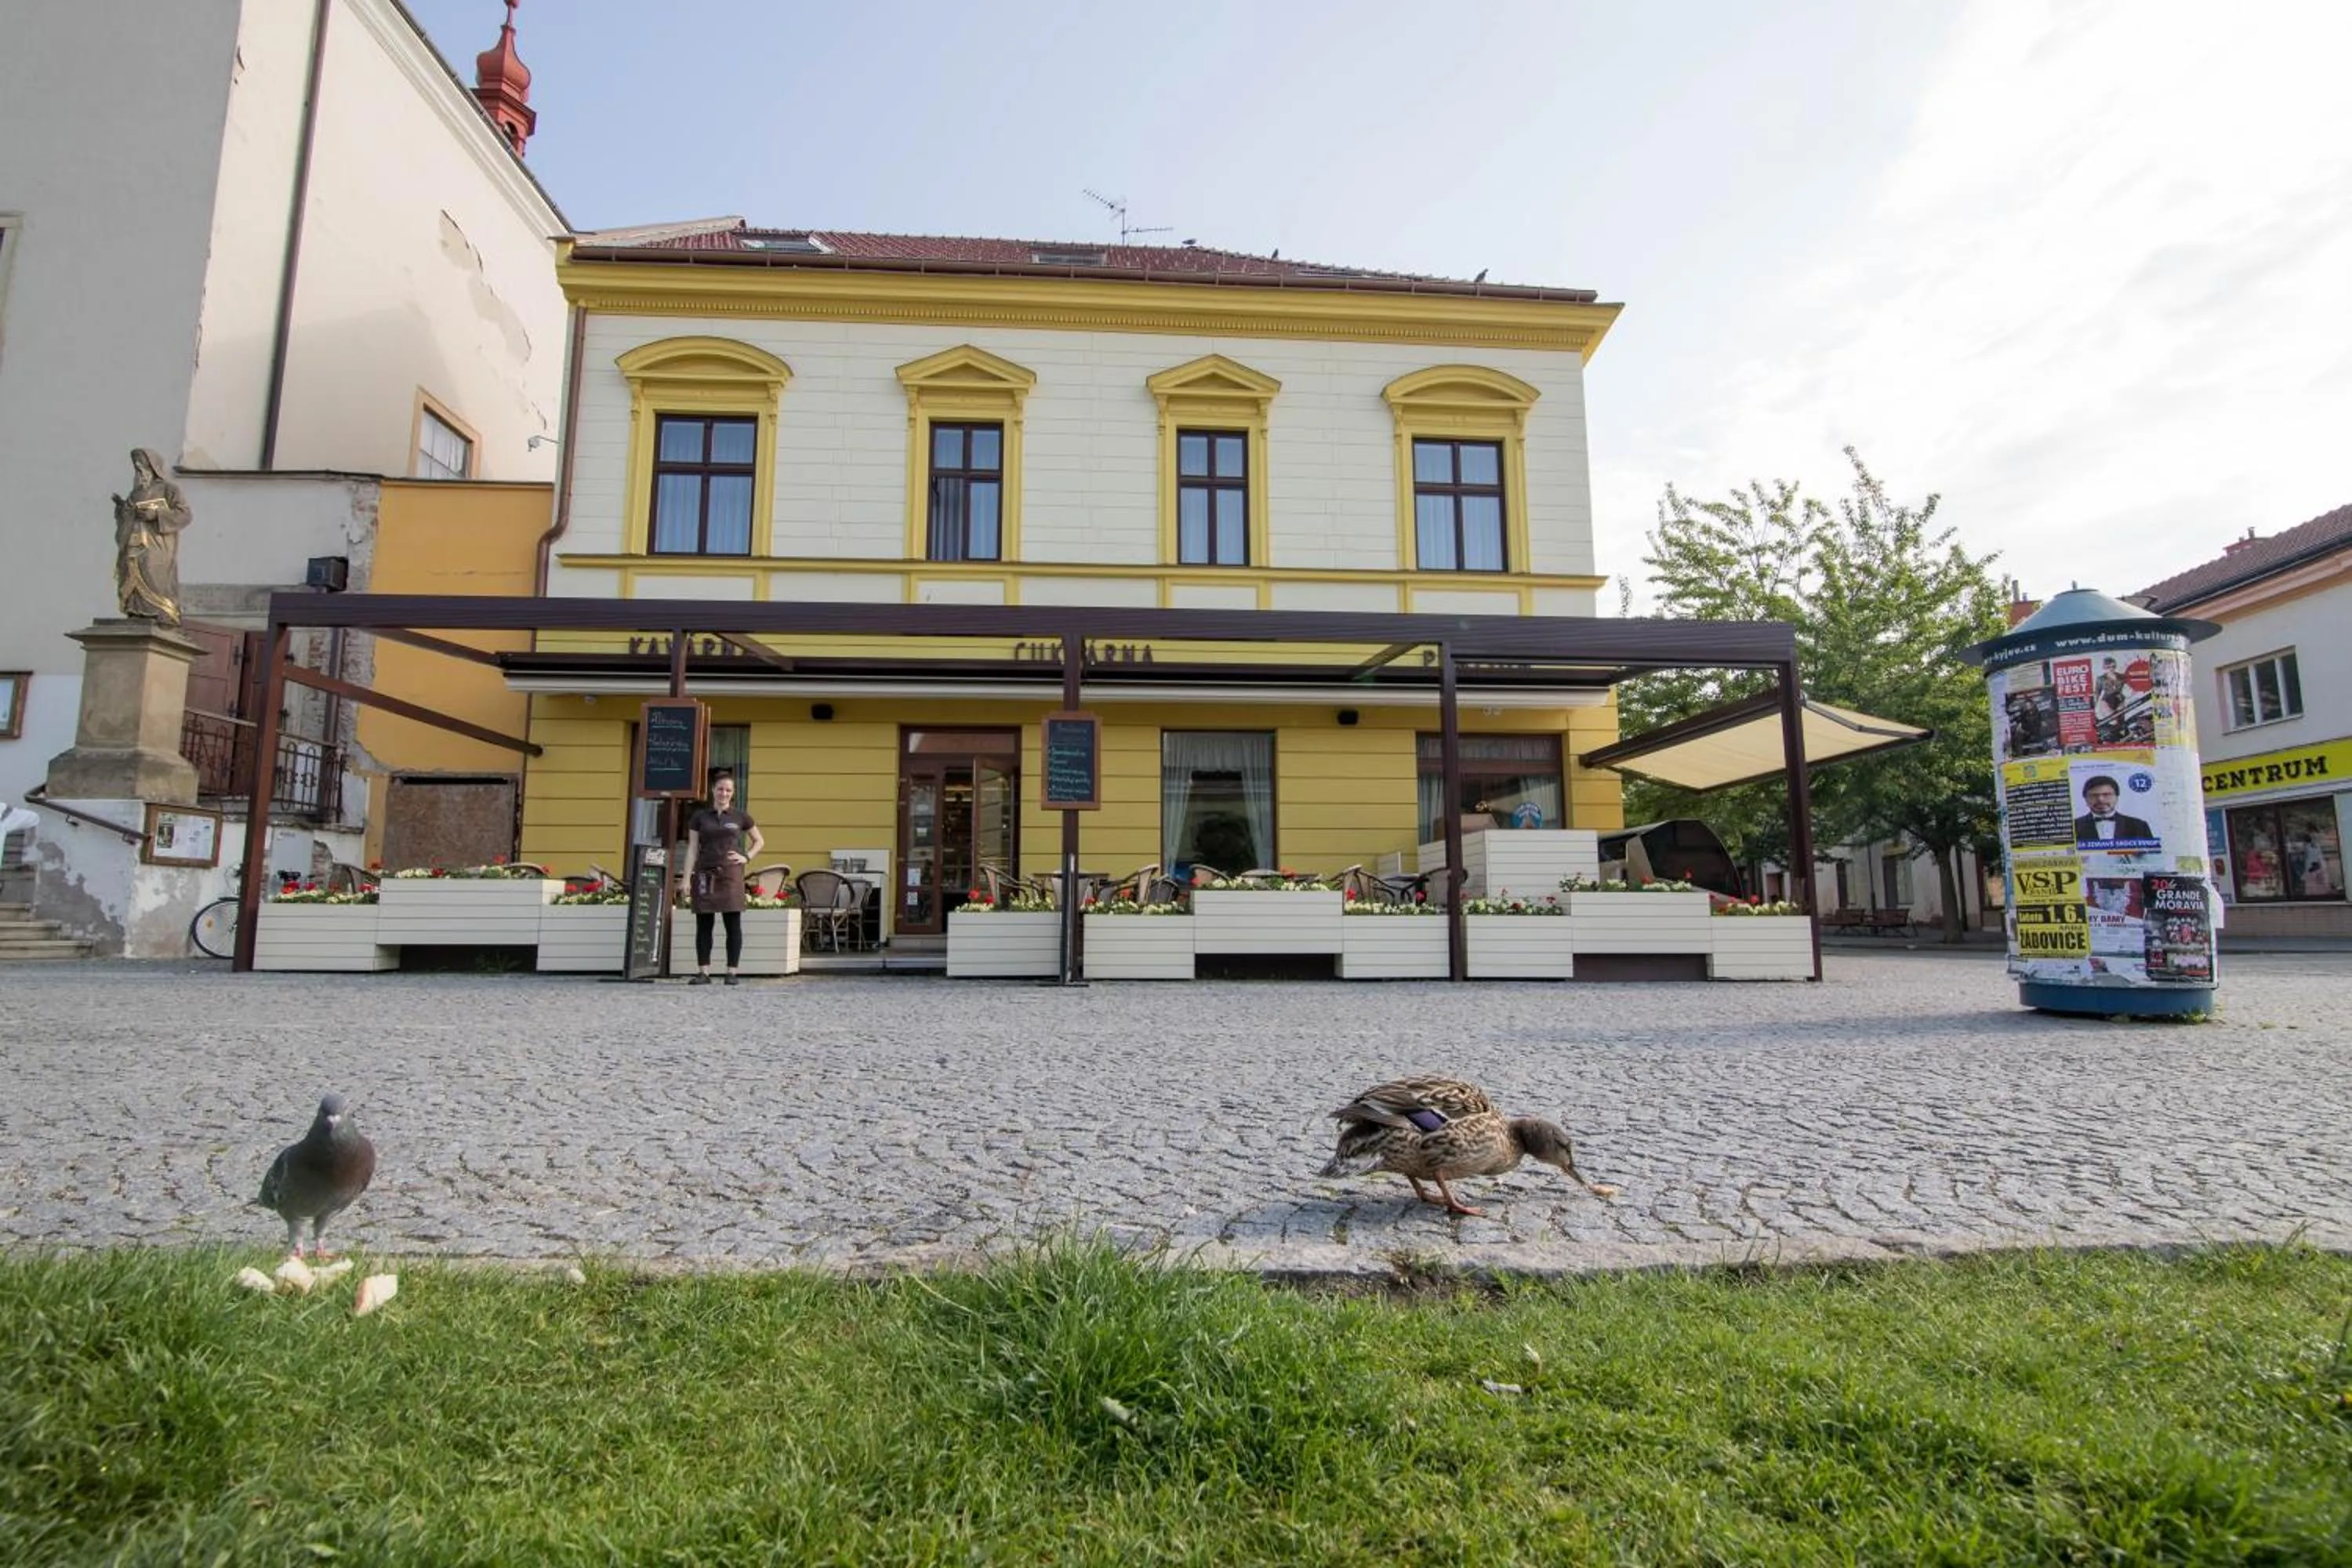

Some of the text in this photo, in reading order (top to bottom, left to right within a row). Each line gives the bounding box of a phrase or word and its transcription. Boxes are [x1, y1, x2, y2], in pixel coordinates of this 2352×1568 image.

[1014, 639, 1153, 663] CUKÁRNA
[2056, 664, 2089, 674] EURO
[2056, 674, 2087, 684] BIKE
[2057, 684, 2087, 695] FEST
[2201, 755, 2329, 793] CENTRUM
[2156, 890, 2201, 901] GRANDE
[2155, 900, 2205, 911] MORAVIA
